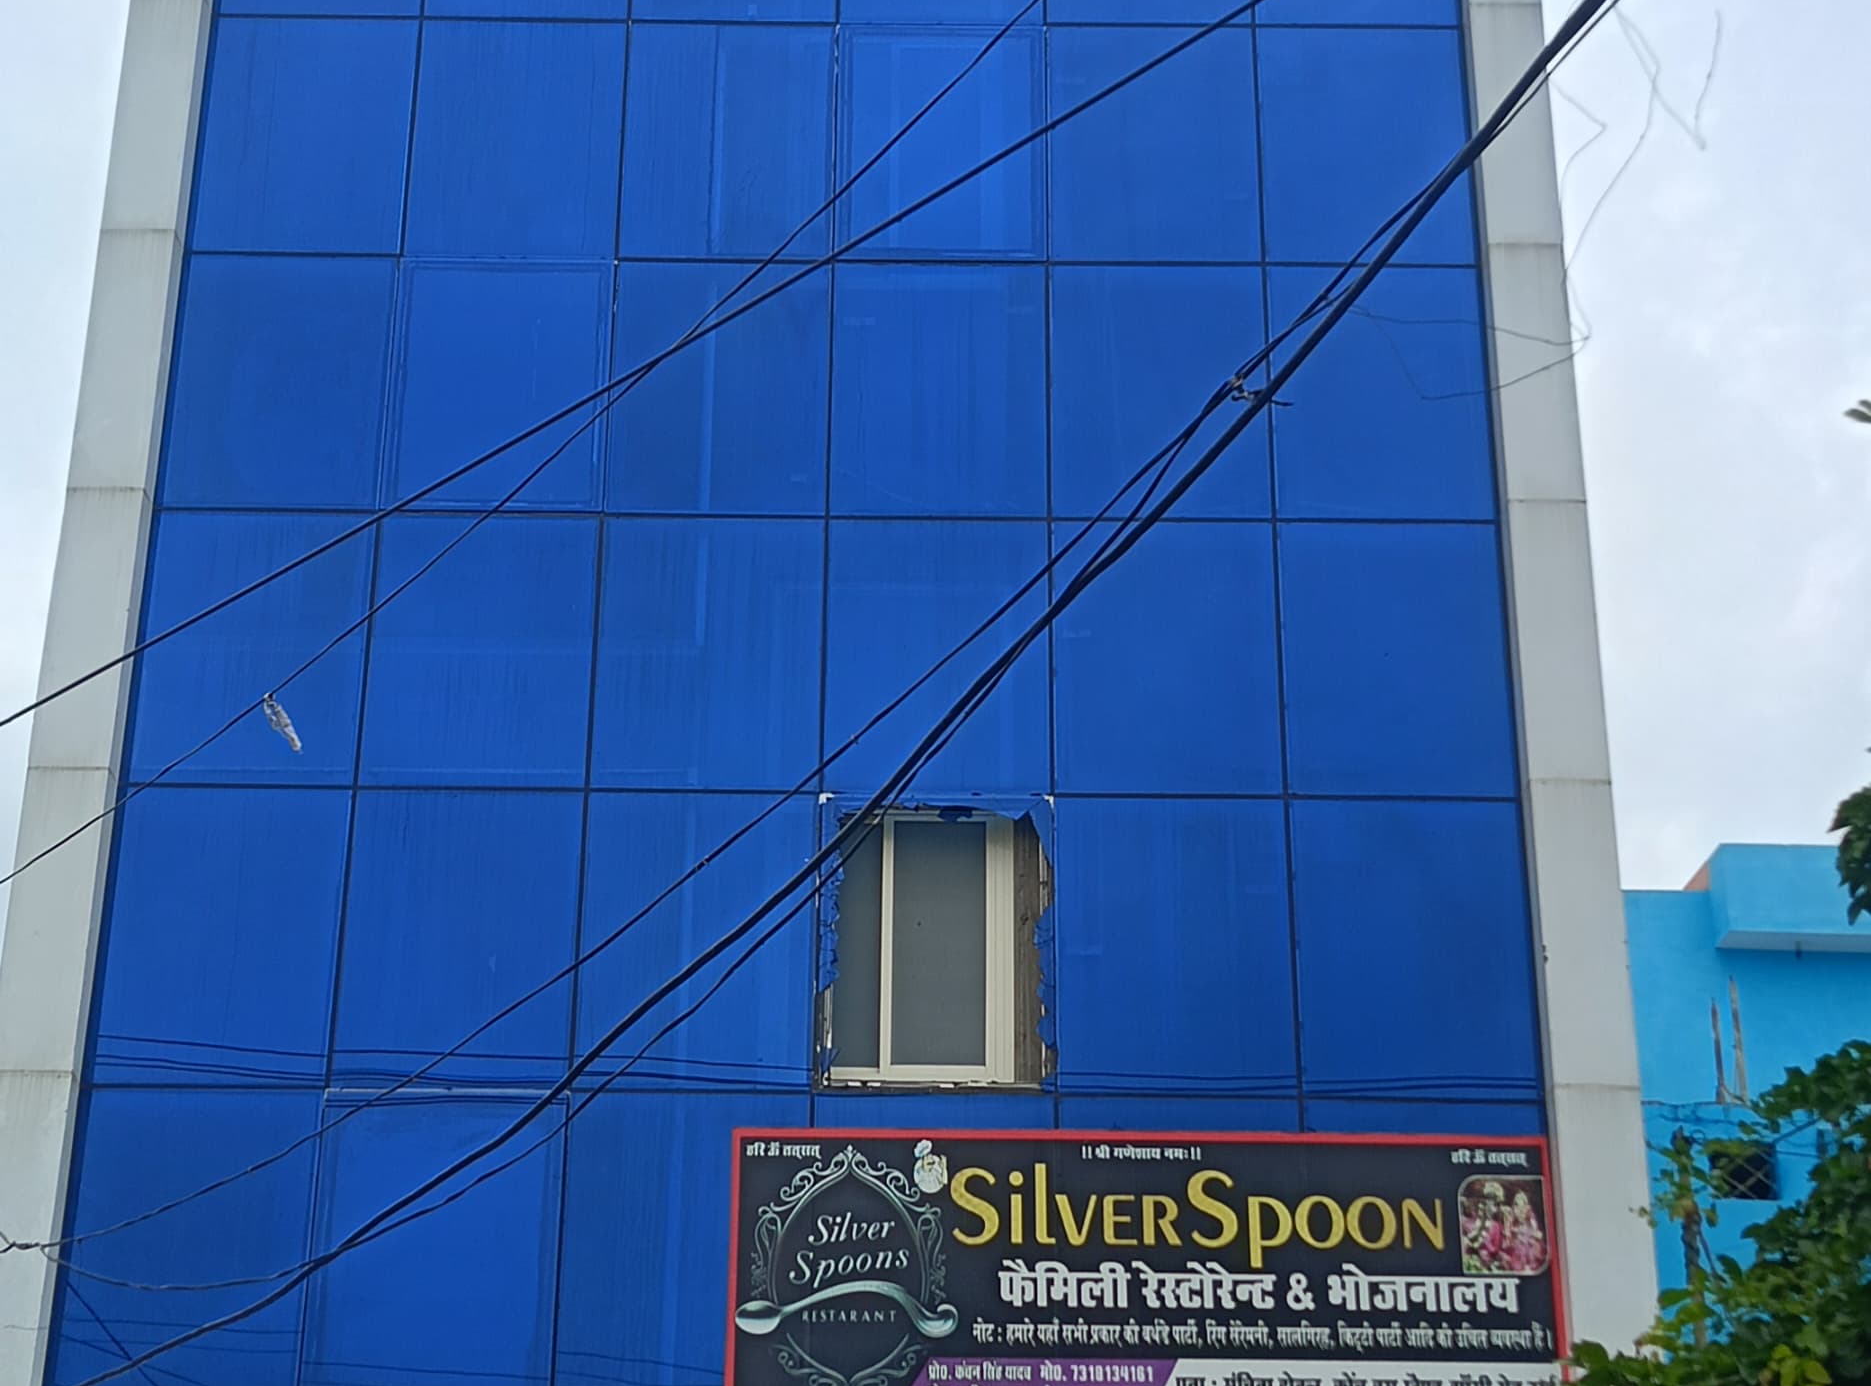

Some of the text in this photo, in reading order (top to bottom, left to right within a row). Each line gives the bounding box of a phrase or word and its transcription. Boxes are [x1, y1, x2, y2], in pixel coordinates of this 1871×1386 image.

[807, 1211, 896, 1246] Silver
[788, 1248, 910, 1289] Spoons
[998, 1259, 1131, 1309] फैमिली
[1285, 1274, 1315, 1312] &
[1327, 1263, 1520, 1314] भोजनालय
[1062, 1317, 1089, 1346] सभी
[1090, 1324, 1123, 1348] प्रकार
